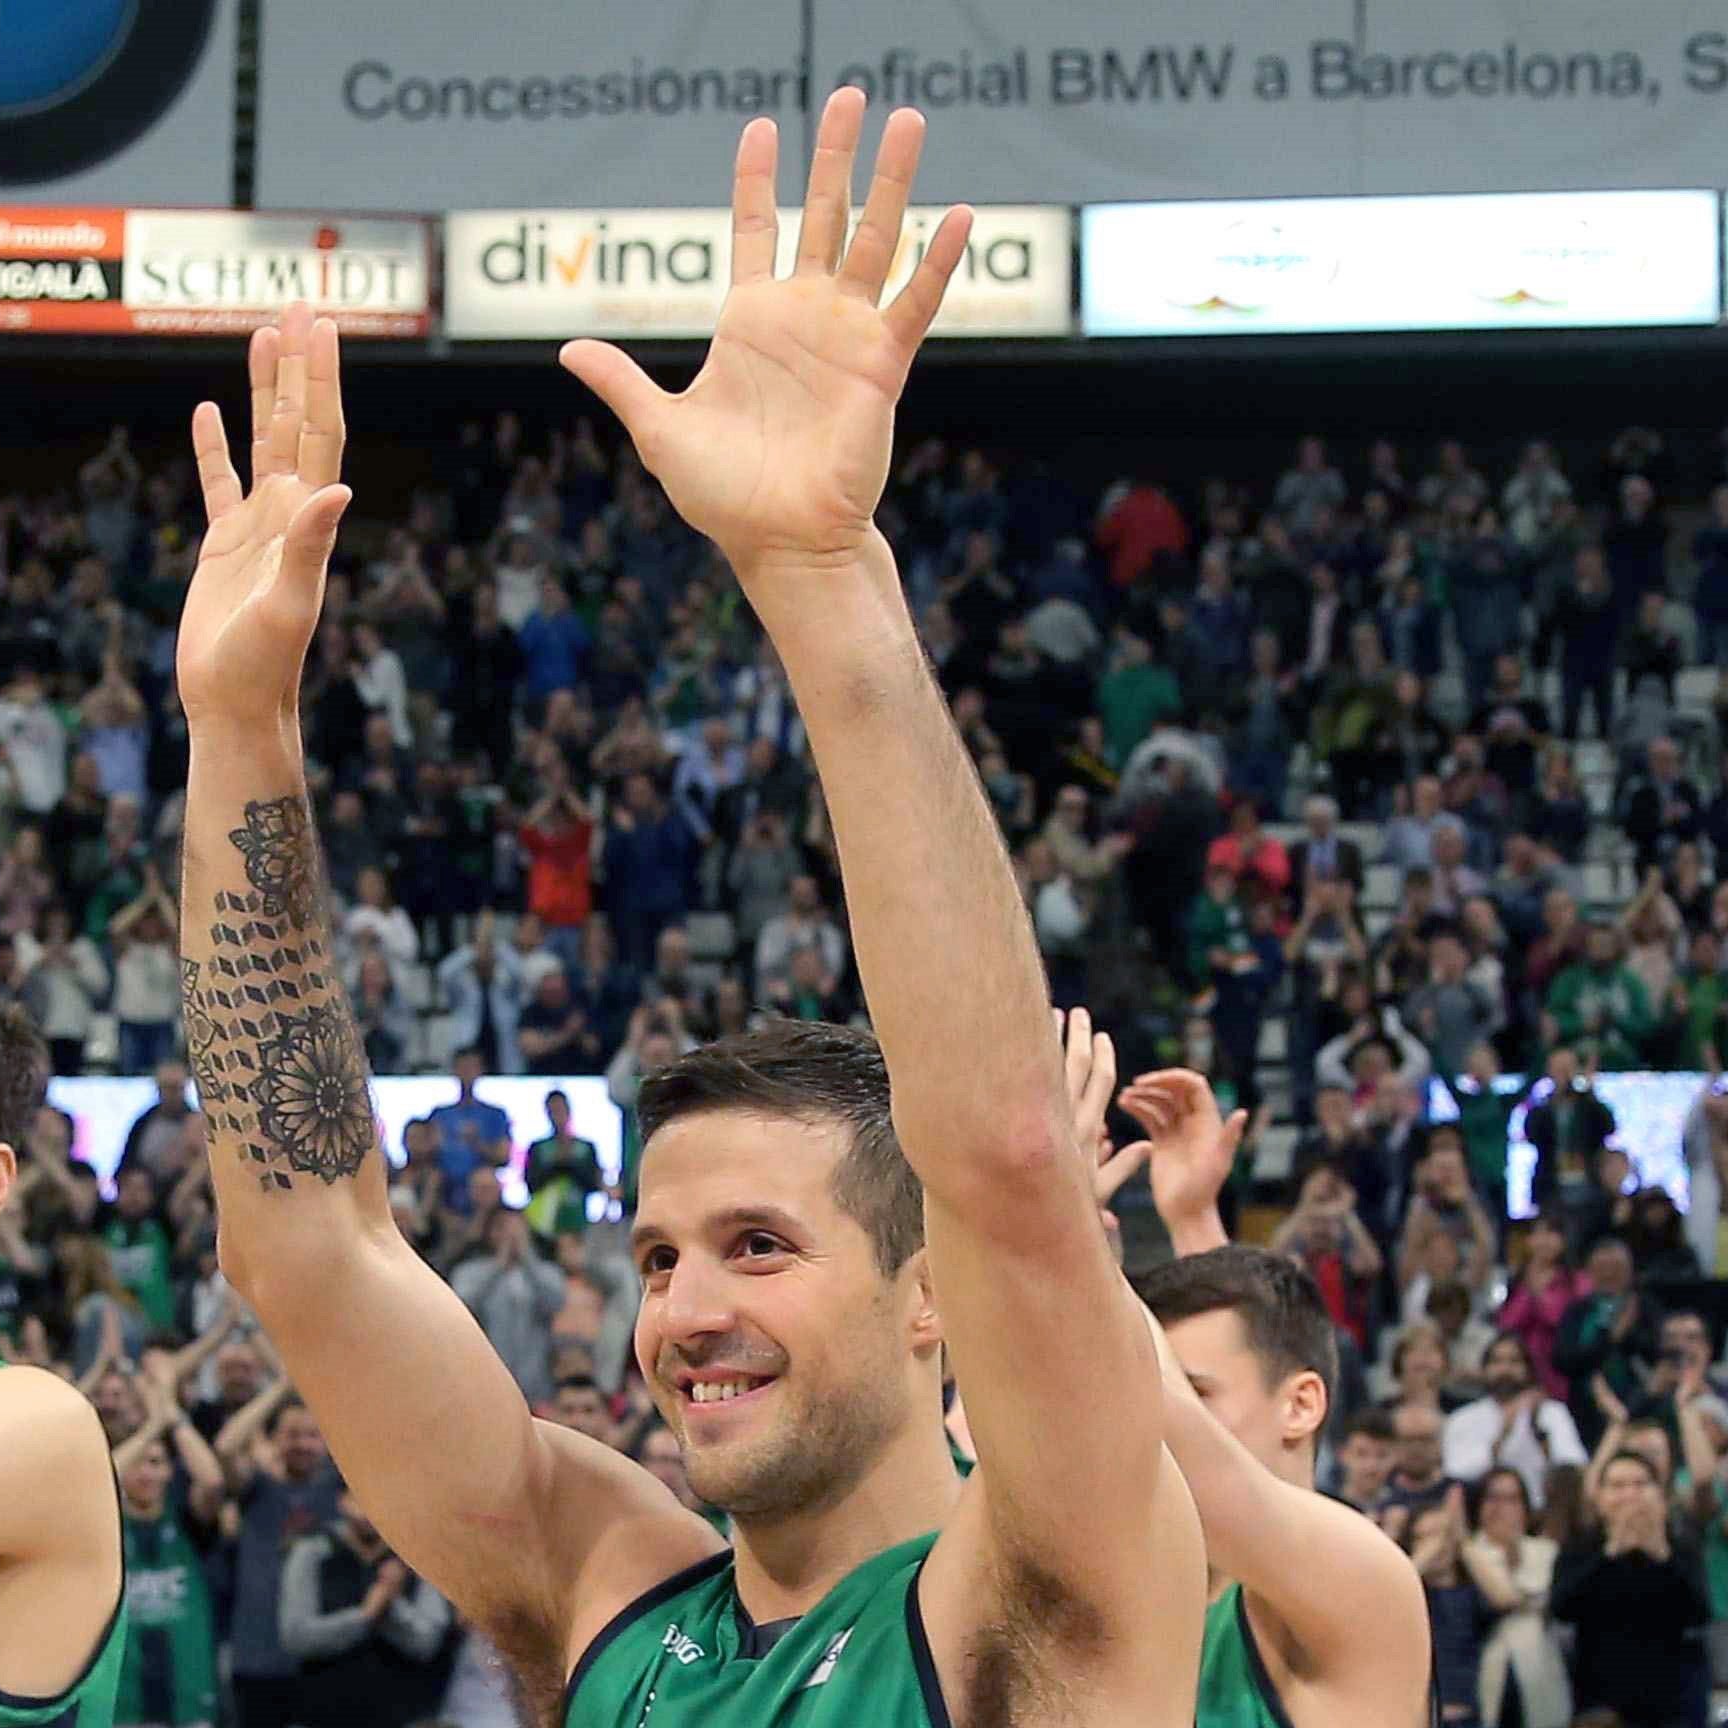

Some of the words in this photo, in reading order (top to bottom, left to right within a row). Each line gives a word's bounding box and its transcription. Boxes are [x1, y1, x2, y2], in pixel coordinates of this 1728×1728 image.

[341, 57, 809, 122] Concessionari
[834, 50, 1029, 108] oficial
[1047, 43, 1234, 104] BMW
[1252, 57, 1290, 101] a
[1308, 38, 1662, 106] Barcelona,
[480, 216, 713, 286] divina
